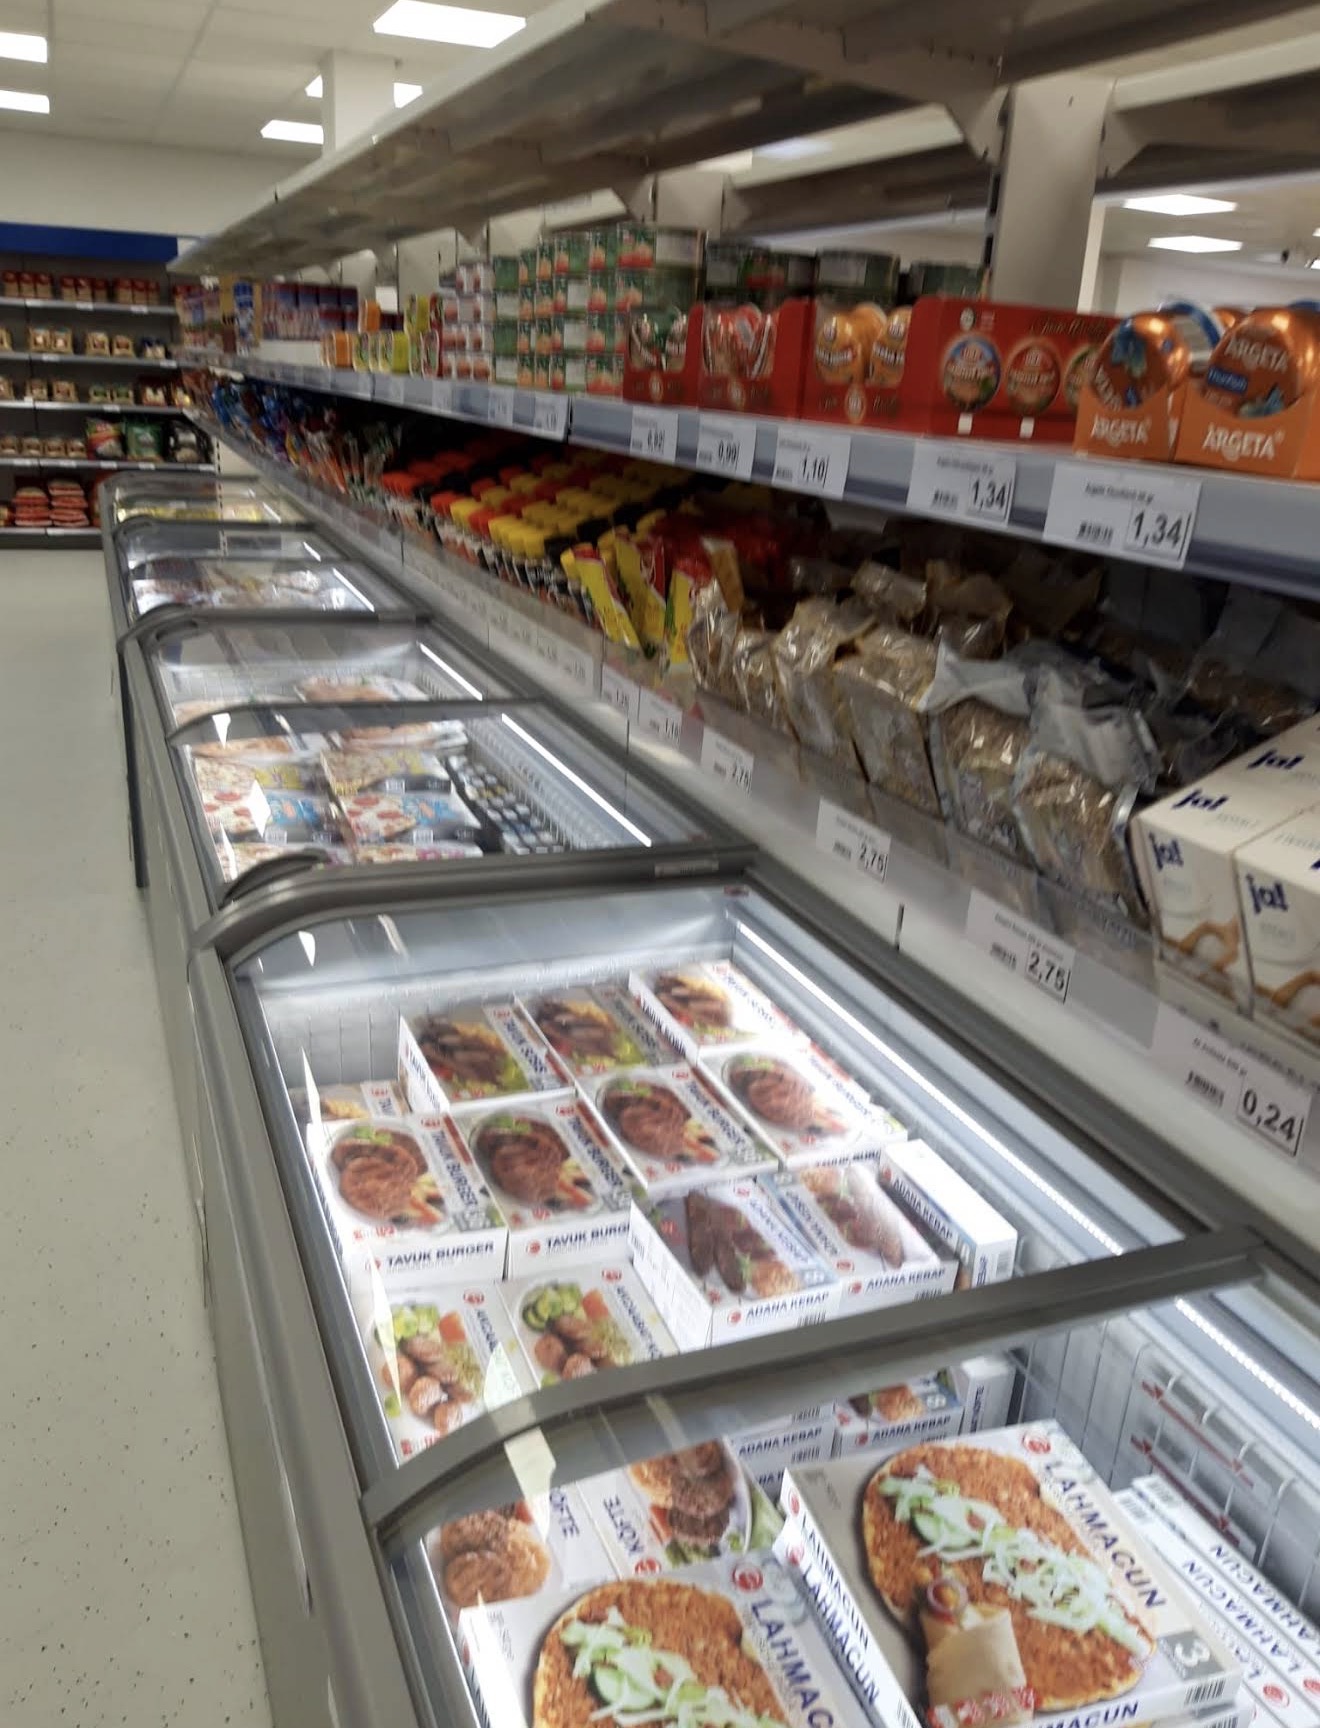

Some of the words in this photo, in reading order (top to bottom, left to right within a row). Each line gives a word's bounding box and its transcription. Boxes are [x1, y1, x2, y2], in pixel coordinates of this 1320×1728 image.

[1090, 413, 1149, 447] ARGETA
[1201, 422, 1276, 462] ARGETA
[972, 479, 1006, 511] 1,34
[1133, 509, 1183, 549] 1,34
[860, 842, 884, 874] 2,75
[1027, 950, 1066, 992] 2,75
[1242, 1088, 1296, 1141] 0,24
[386, 1249, 431, 1268] TAVUK
[436, 1240, 494, 1260] BURGER
[547, 1231, 587, 1249] TAVUK
[590, 1221, 630, 1240] BURG
[1045, 1460, 1167, 1609] LAHMACUN
[1183, 1558, 1301, 1673] LAHMACUN
[1208, 1542, 1320, 1657] AHMACUN
[802, 1563, 880, 1705] LAHMACUN
[1175, 1640, 1212, 1668] 3
[751, 1597, 834, 1728] LAHMAC
[1039, 1699, 1141, 1728] MACUN
